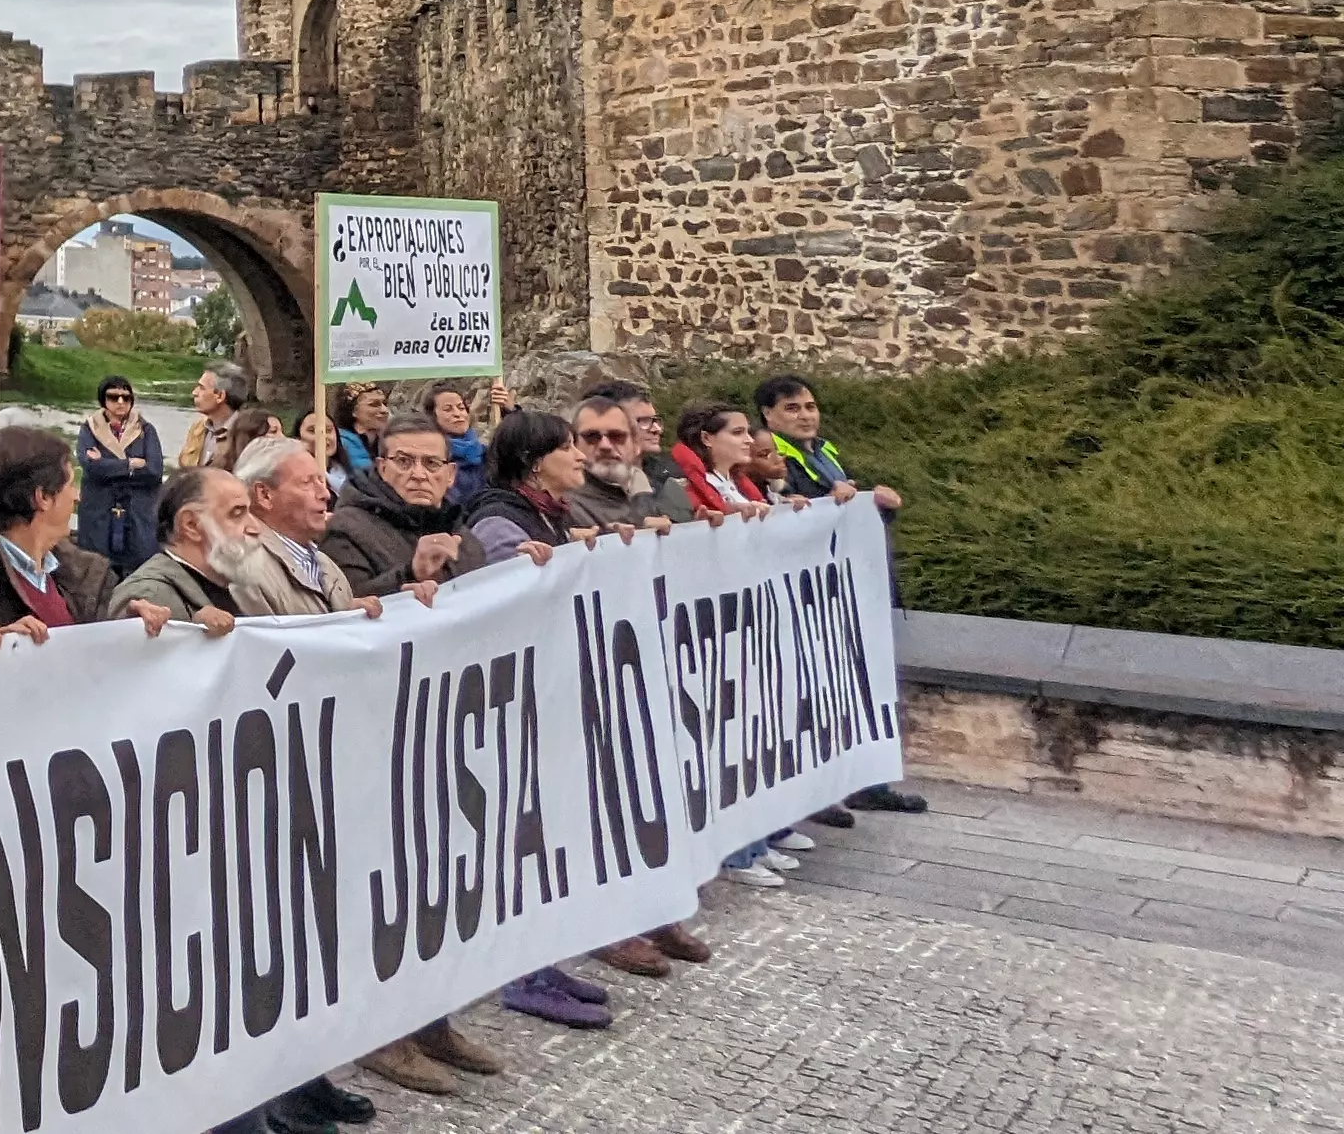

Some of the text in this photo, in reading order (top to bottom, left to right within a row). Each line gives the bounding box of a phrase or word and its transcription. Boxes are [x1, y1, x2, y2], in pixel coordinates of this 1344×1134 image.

[333, 215, 464, 262] ¿EXPROPIACIONES
[384, 258, 416, 308] BIEN
[459, 312, 489, 331] BIEN
[434, 335, 490, 358] QUIEN?
[369, 641, 569, 982] JUSTA.
[573, 590, 669, 886] NO
